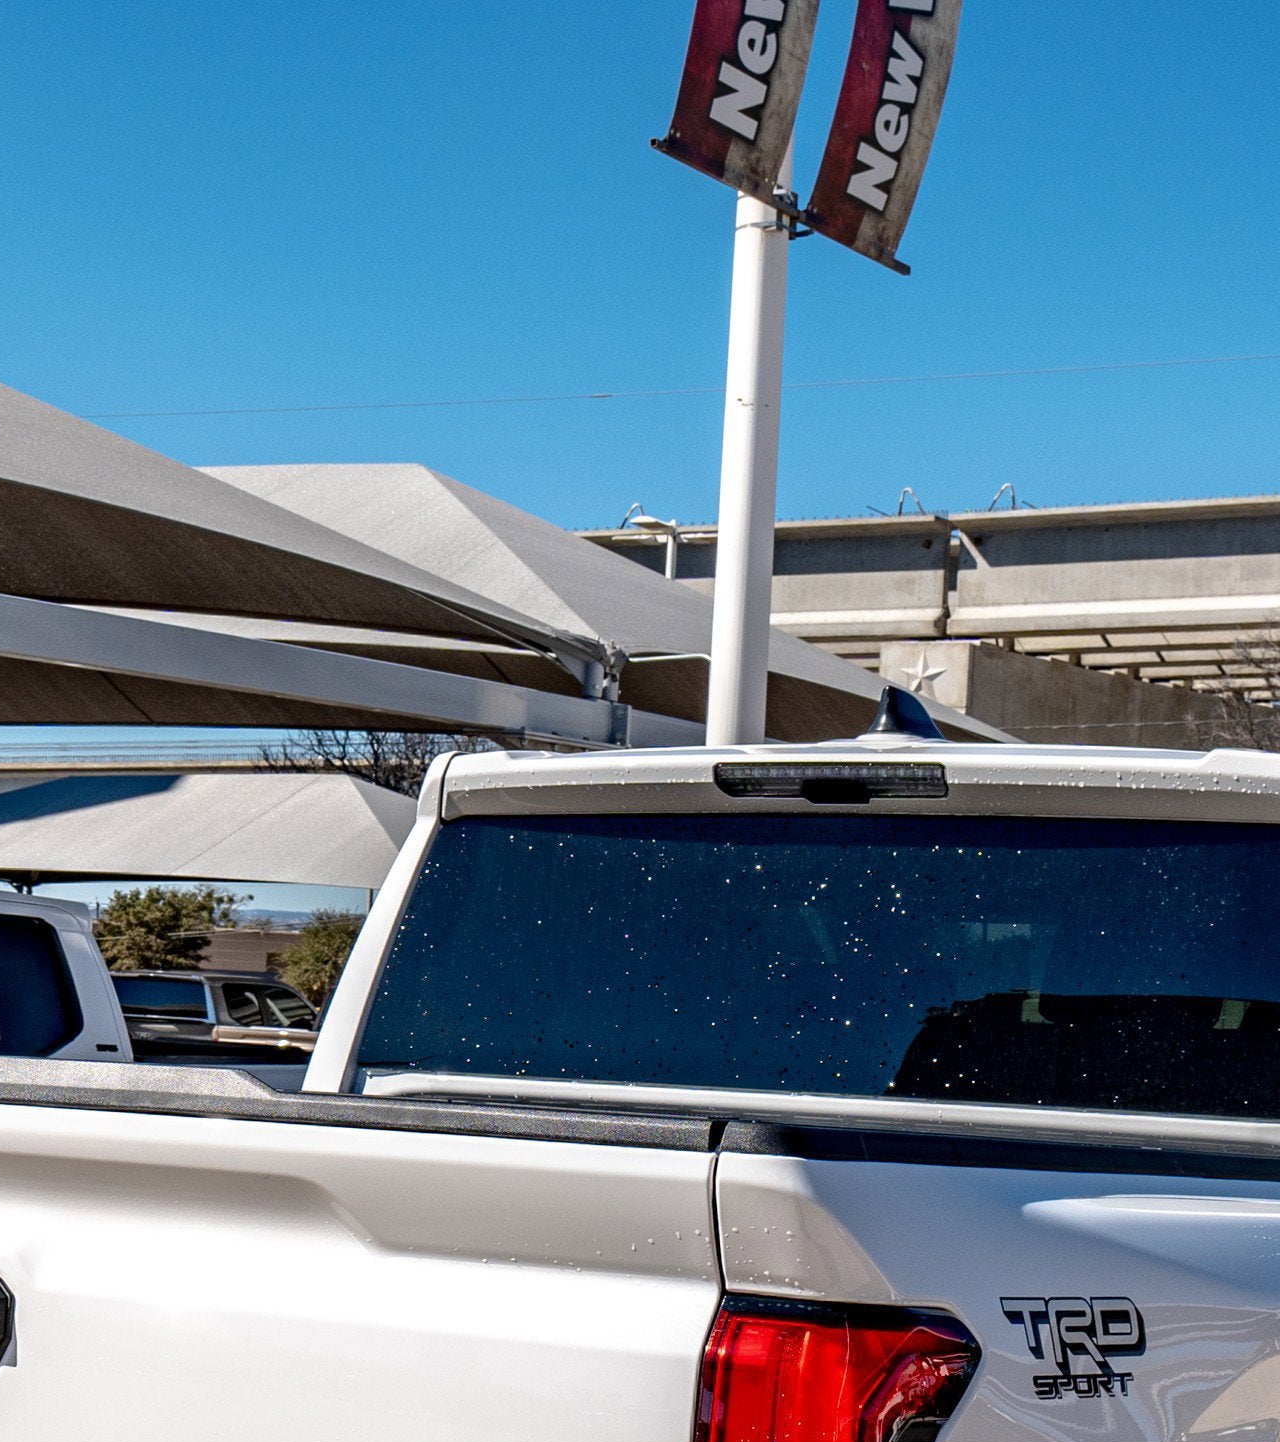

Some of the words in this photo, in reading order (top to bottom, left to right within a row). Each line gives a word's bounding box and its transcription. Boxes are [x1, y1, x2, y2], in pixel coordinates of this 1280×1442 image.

[846, 30, 924, 212] New
[1000, 1296, 1147, 1376] TRD
[1032, 1372, 1134, 1400] SPORT
